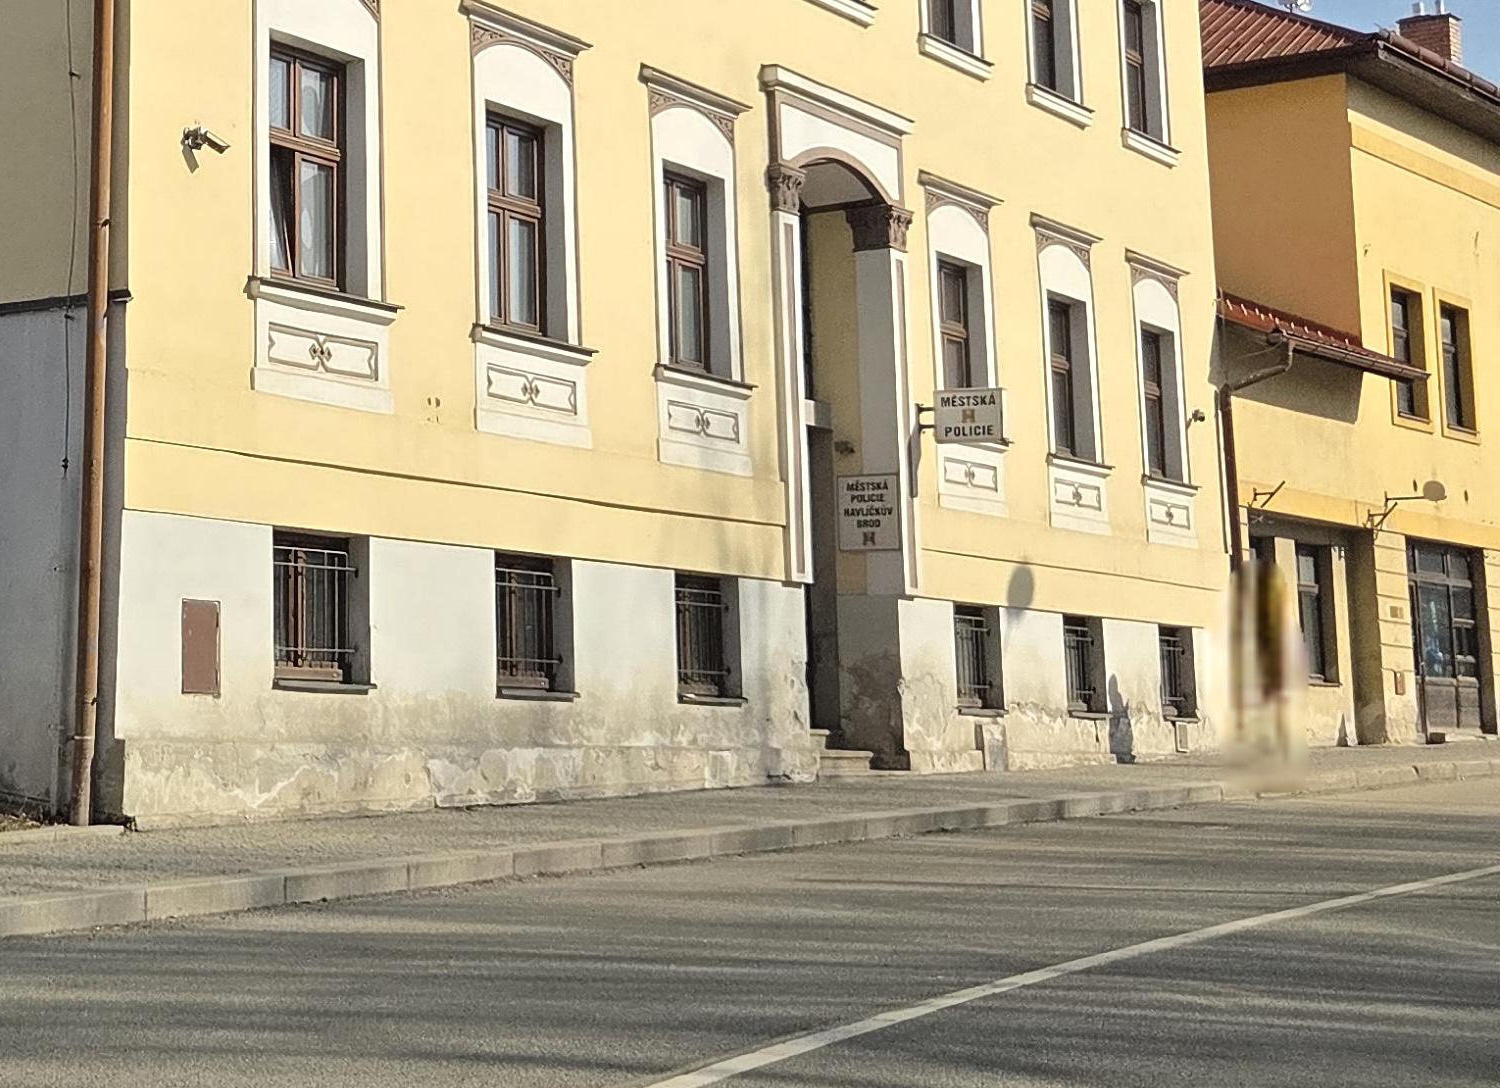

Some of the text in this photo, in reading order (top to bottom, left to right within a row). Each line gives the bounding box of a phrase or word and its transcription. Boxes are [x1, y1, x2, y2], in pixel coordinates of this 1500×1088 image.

[944, 424, 995, 437] POLICIE
[850, 493, 885, 504] POLICIE
[856, 518, 881, 529] BROD
